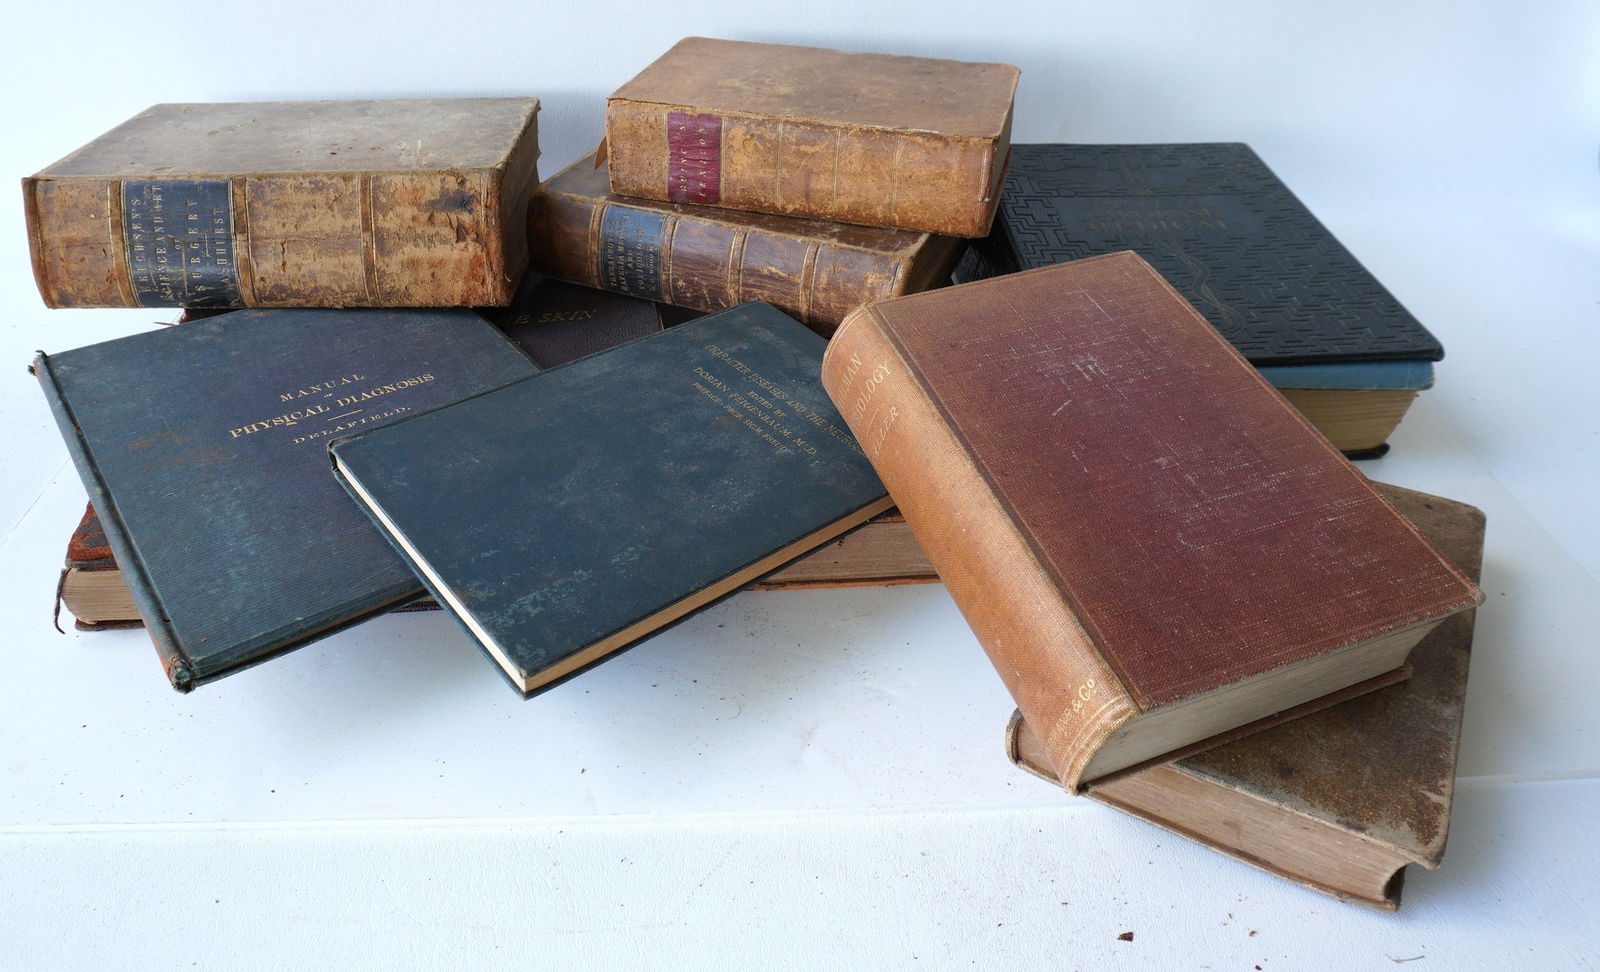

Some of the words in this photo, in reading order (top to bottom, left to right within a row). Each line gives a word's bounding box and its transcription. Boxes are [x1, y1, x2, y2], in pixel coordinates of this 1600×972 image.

[154, 216, 165, 241] AND
[131, 199, 152, 293] ERICHSEN'S
[187, 200, 206, 292] SURGERY
[212, 208, 230, 283] ASHHURST
[538, 309, 598, 324] SKIN
[279, 373, 365, 402] MANUAL
[693, 367, 731, 393] DORIAN
[704, 344, 751, 375] CHARACTER
[747, 373, 789, 400] DISEASES
[785, 400, 807, 413] AND
[805, 411, 828, 427] THE
[228, 404, 330, 439] PHYSICAL
[337, 373, 436, 407] DIAGNOSIS
[746, 391, 773, 409] EDITED
[773, 409, 787, 418] BY
[762, 434, 788, 452] FREUD
[1071, 699, 1083, 712] &
